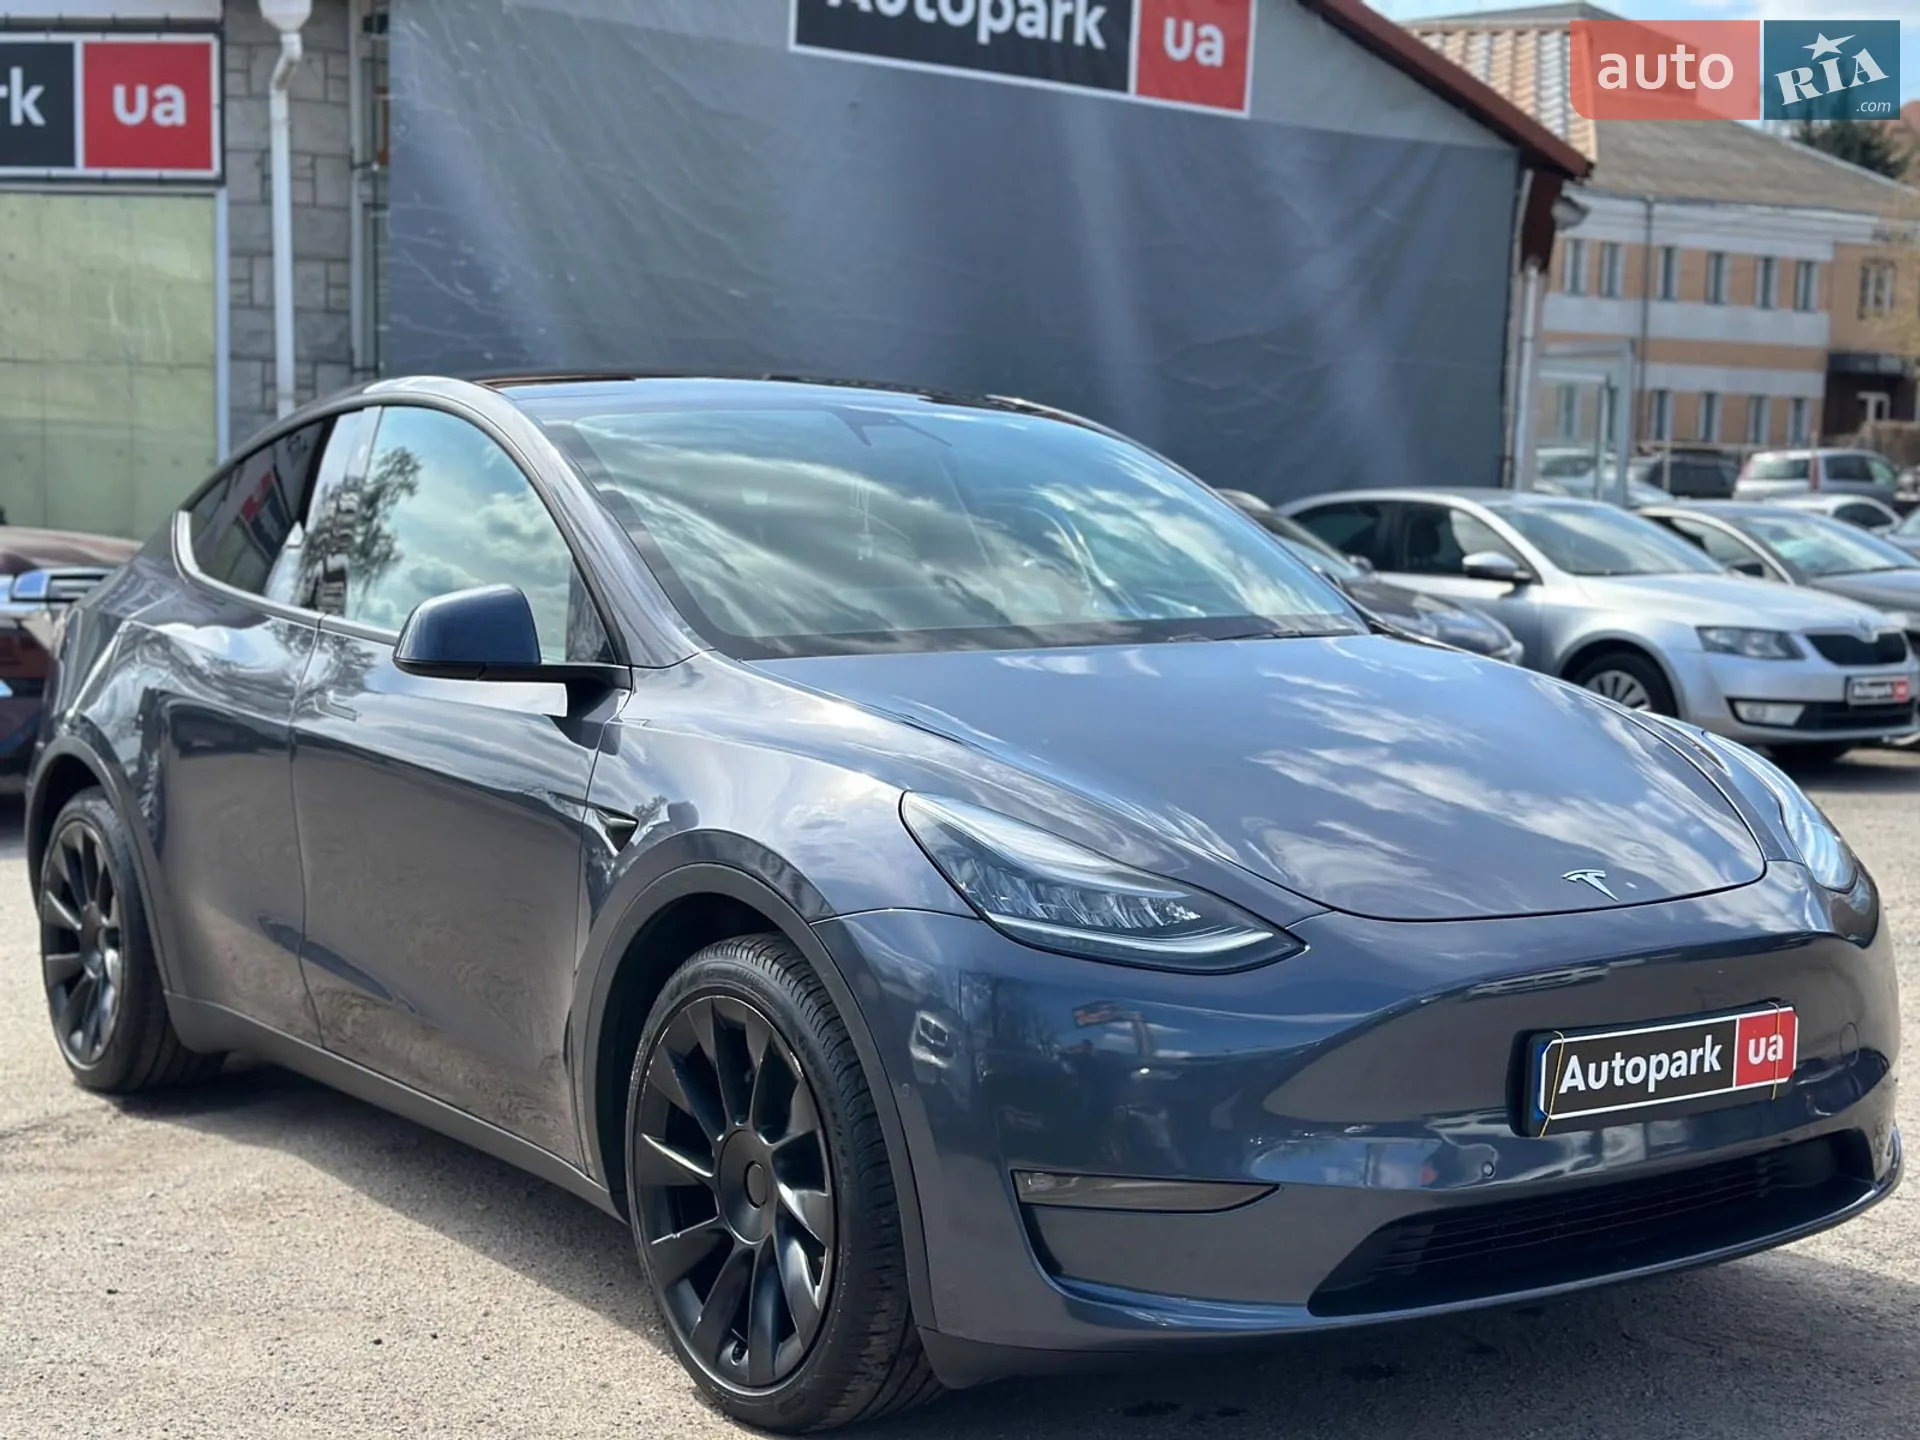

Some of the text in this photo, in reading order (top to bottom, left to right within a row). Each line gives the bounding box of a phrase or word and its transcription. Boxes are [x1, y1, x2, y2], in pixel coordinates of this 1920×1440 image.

[826, 0, 1224, 67] opark ua
[113, 84, 187, 127] ua
[1558, 1033, 1784, 1094] Autopark ua
